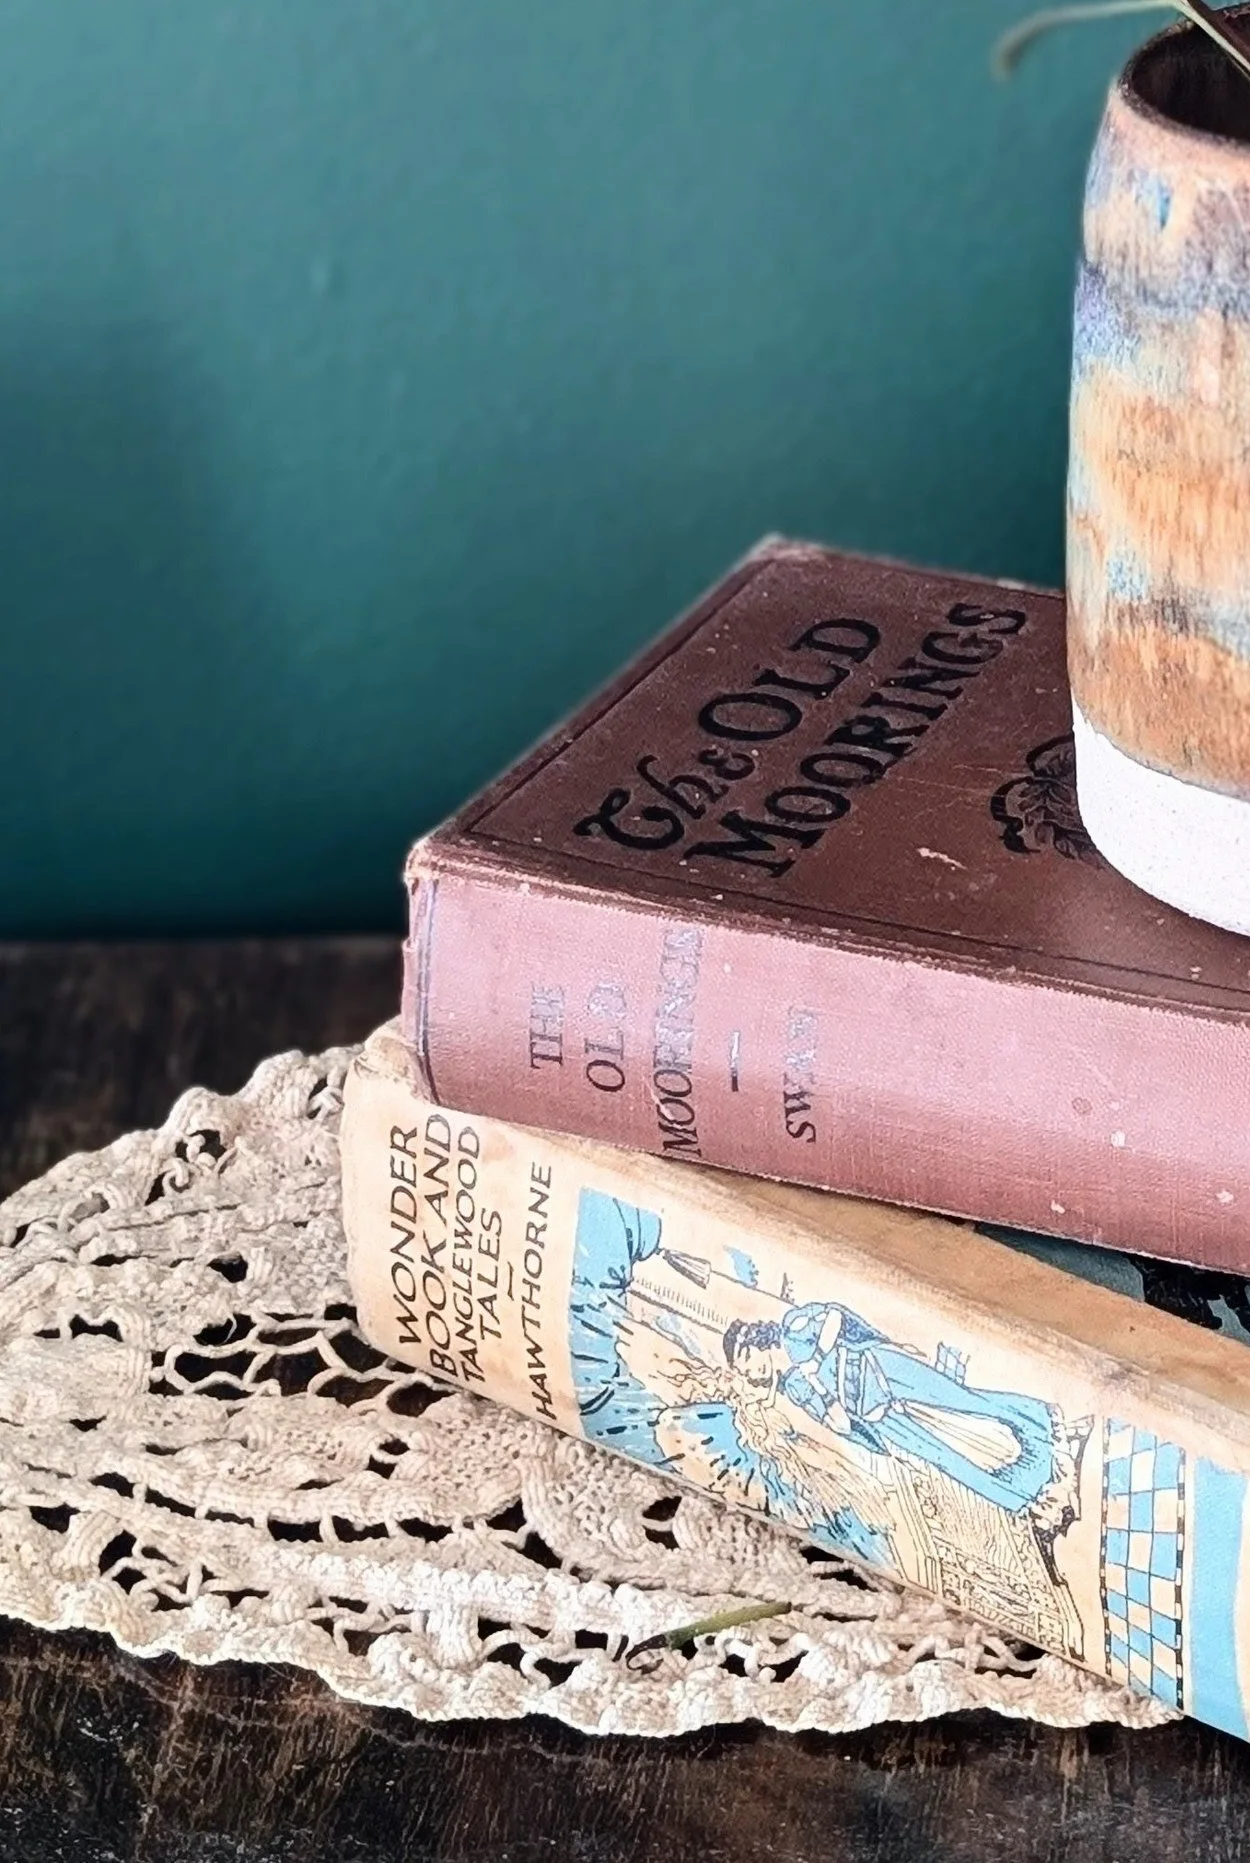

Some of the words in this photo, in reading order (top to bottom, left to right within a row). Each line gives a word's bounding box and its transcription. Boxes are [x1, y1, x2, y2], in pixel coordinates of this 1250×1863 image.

[685, 603, 1027, 878] MOORINGS
[700, 618, 882, 741] OLD
[529, 985, 565, 1070] THE
[390, 1125, 422, 1344] WONDER
[423, 1113, 452, 1228] AND
[421, 1229, 458, 1378] BOOK
[452, 1126, 486, 1383] TANGLEWOOD
[477, 1207, 503, 1340] TALES
[521, 1161, 557, 1421] HAWTHORNE
